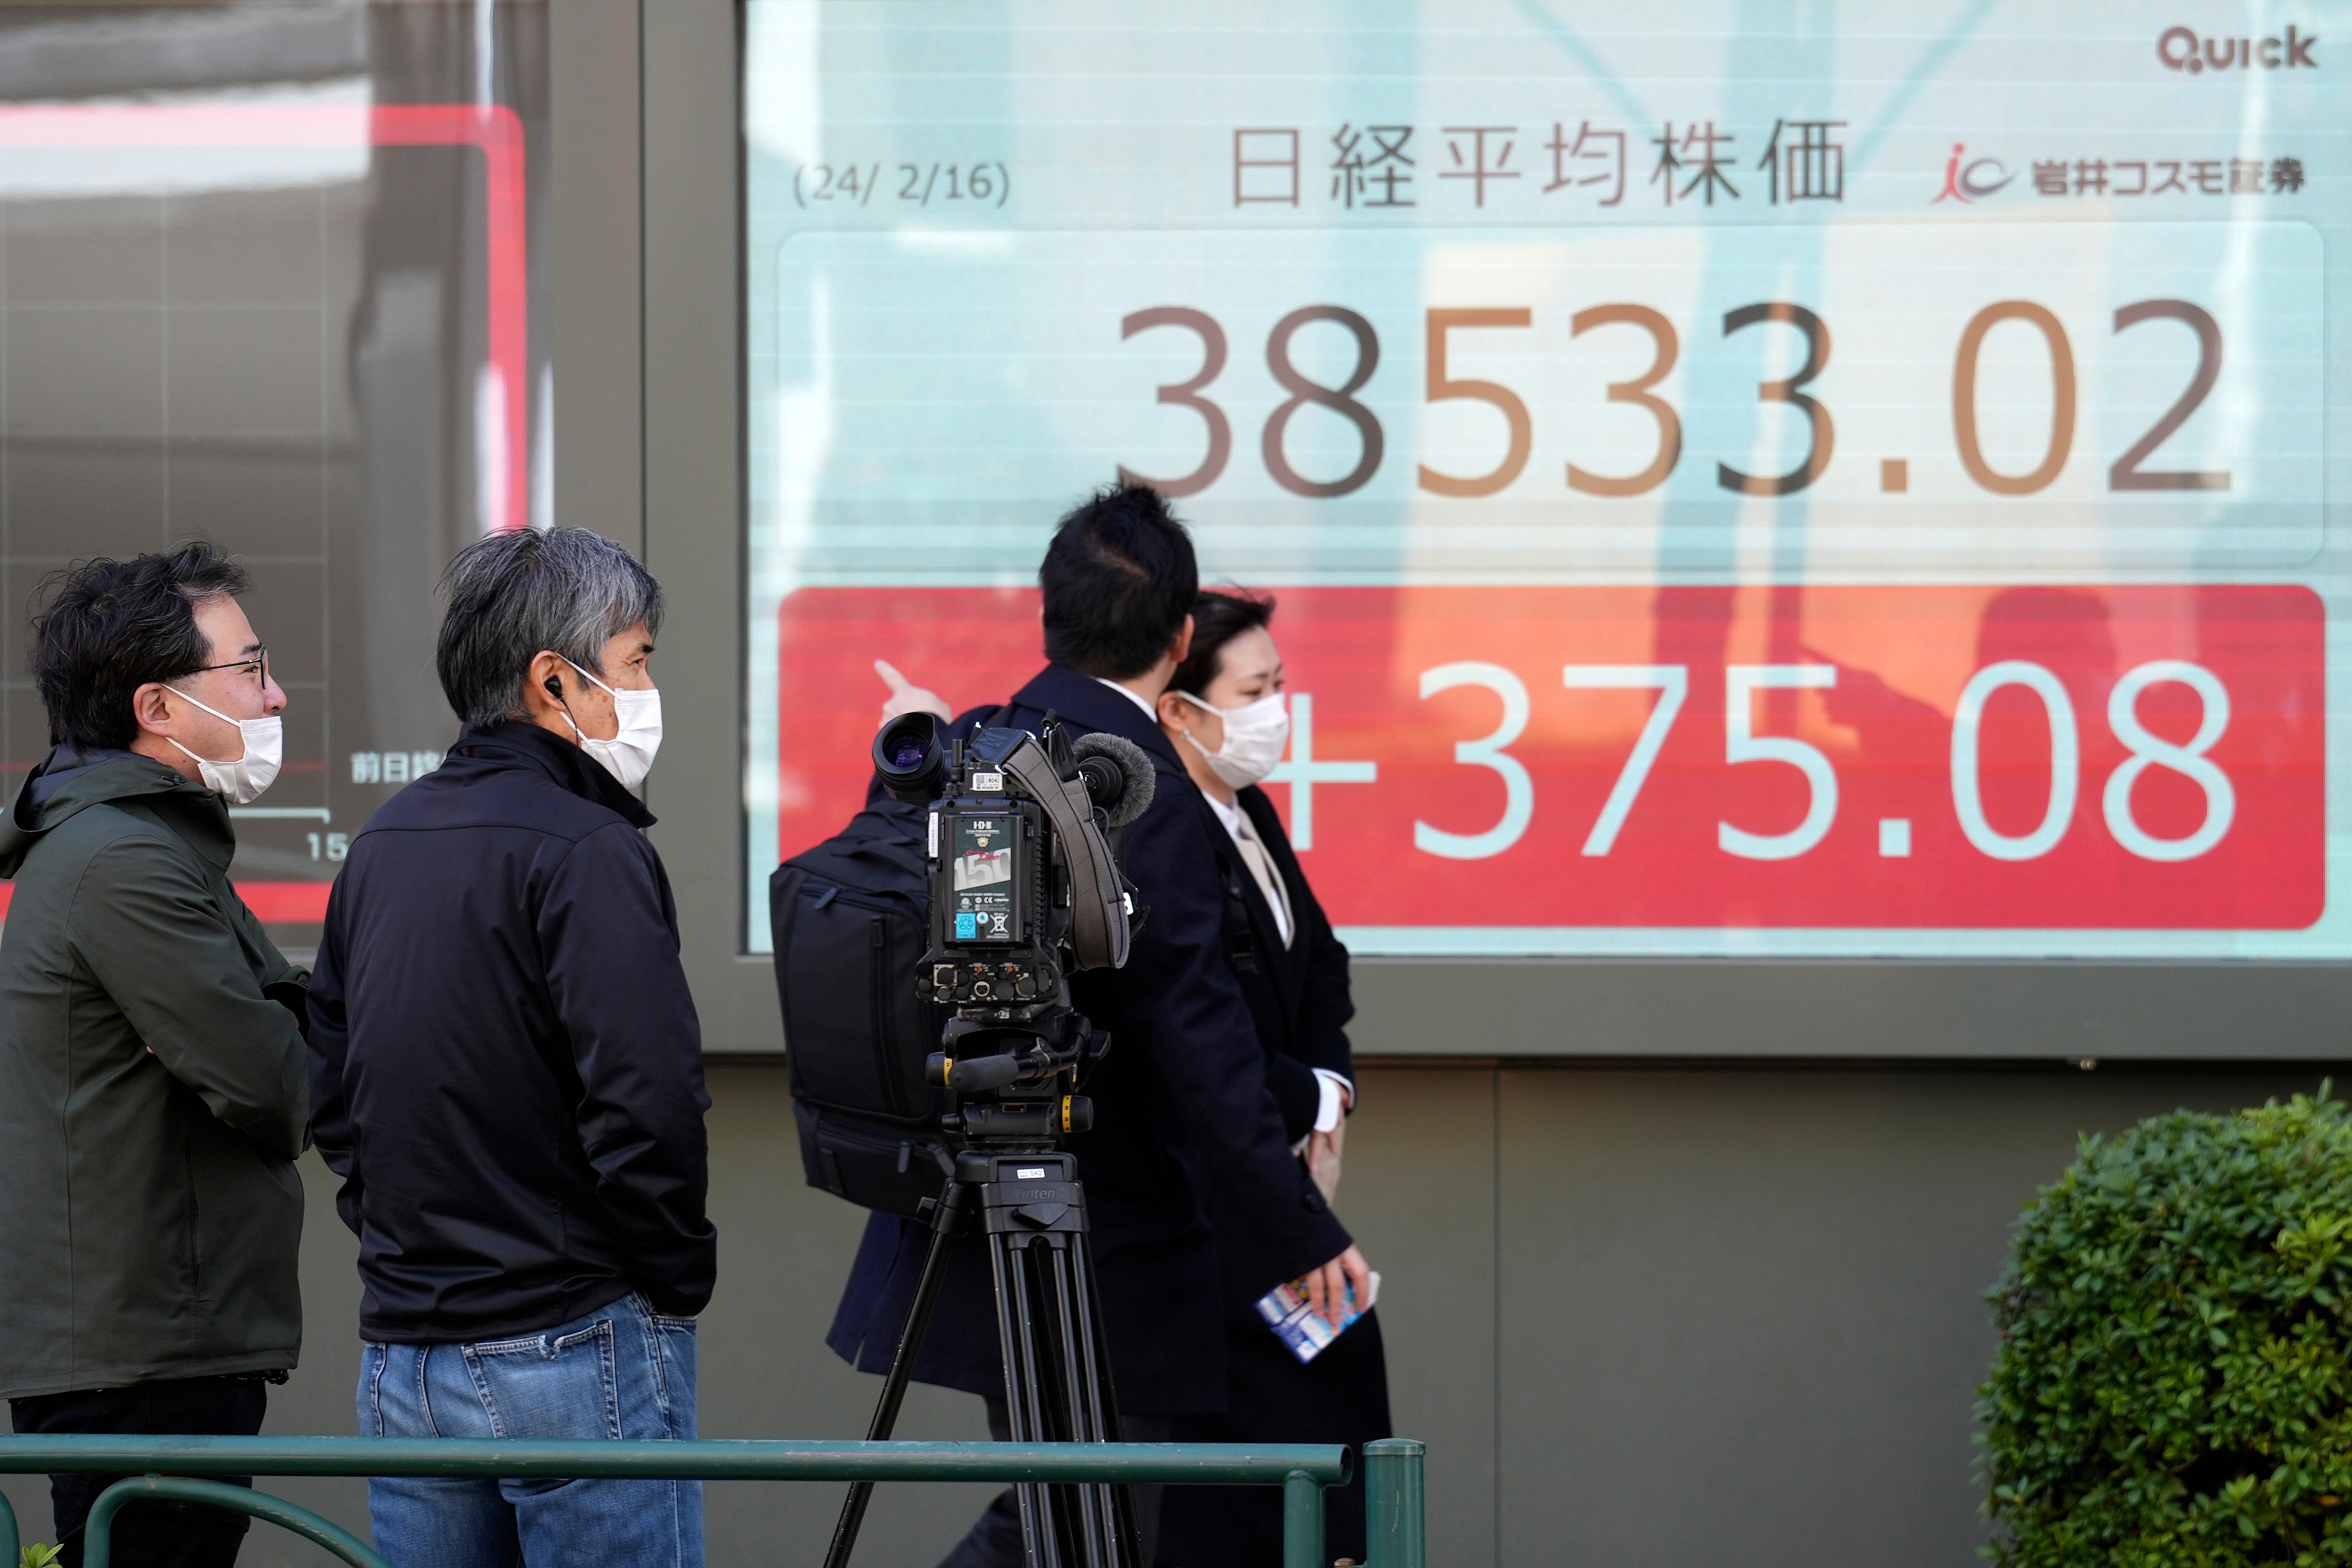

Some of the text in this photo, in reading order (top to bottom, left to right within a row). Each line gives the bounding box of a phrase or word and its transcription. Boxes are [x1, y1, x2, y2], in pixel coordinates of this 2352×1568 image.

[2157, 25, 2318, 74] Quick
[1233, 118, 1849, 208] 日経平均株価
[2032, 157, 2304, 196] 岩井コスモ証券
[1117, 298, 2231, 498] 38533.02
[1258, 660, 2235, 861] +375.08
[306, 832, 348, 861] 15
[954, 847, 1011, 891] 150
